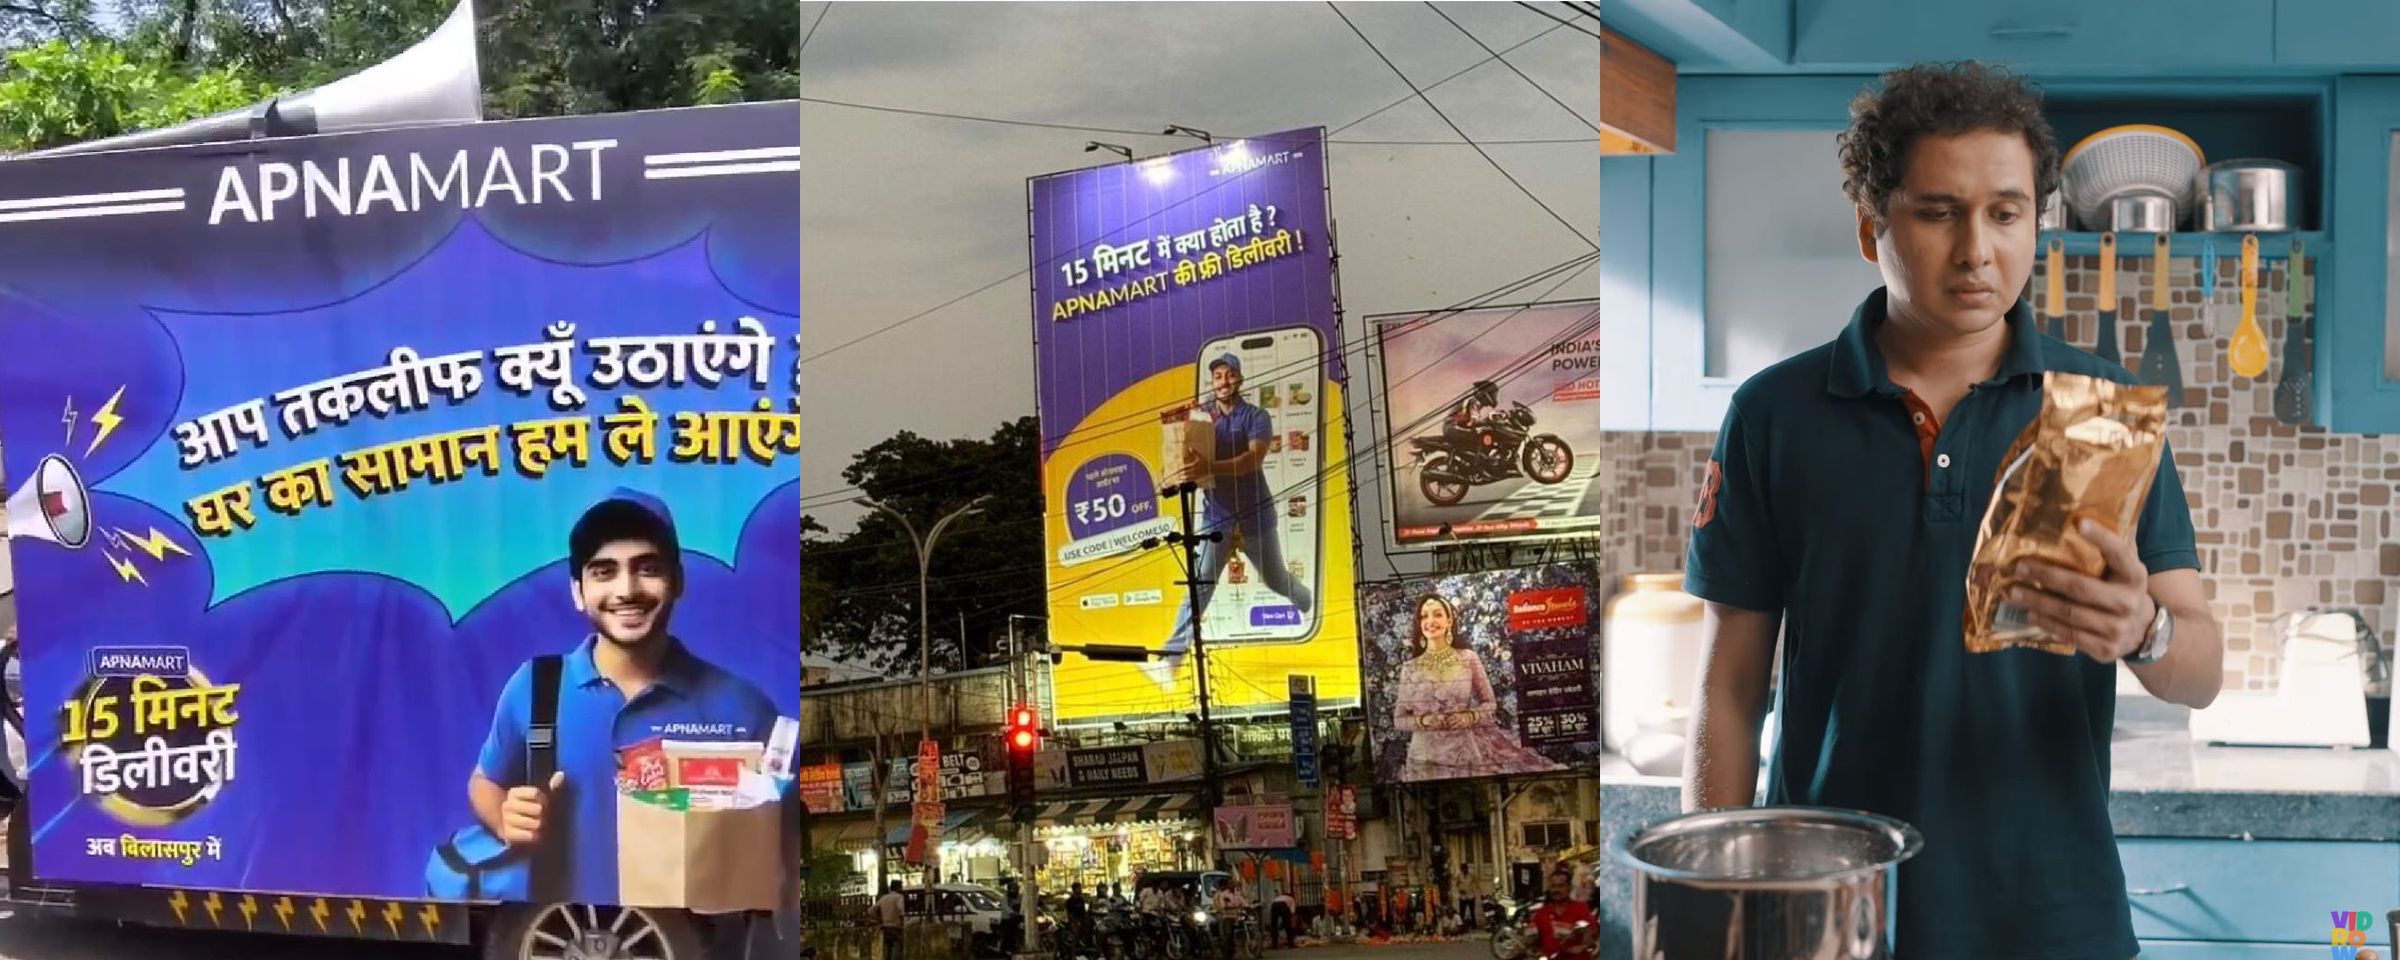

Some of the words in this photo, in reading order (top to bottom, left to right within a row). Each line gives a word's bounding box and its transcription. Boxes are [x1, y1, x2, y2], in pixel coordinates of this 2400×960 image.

[208, 139, 618, 225] APNAMART
[1061, 258, 1089, 287] 15
[1092, 238, 1151, 279] मिनट
[1156, 234, 1172, 260] में
[1173, 230, 1207, 255] क्या
[1208, 215, 1247, 248] होता
[1248, 203, 1263, 234] है
[1052, 271, 1169, 322] APNAMART
[1172, 259, 1197, 286] की
[1226, 228, 1293, 271] डिलीवरी
[1553, 355, 1600, 371] POWE
[172, 398, 268, 466] आप
[273, 346, 484, 435] तकलीफ
[494, 320, 587, 405] क्यूँ
[587, 315, 776, 384] उठाएंगे
[187, 480, 257, 533] घर
[260, 456, 333, 510] का
[339, 424, 500, 494] सामान
[512, 416, 592, 474] हम
[602, 394, 659, 460] ले
[1074, 493, 1126, 525] ₹50
[1064, 549, 1082, 561] USE
[1083, 540, 1108, 555] CODE
[100, 654, 184, 670] APNAMART
[1521, 658, 1584, 675] VIVAHAM
[60, 696, 119, 742] 15
[130, 673, 241, 734] मिनट
[664, 723, 733, 735] APNAMART
[80, 729, 238, 794] डिलीवरी
[942, 753, 965, 767] BELT
[206, 835, 223, 861] में
